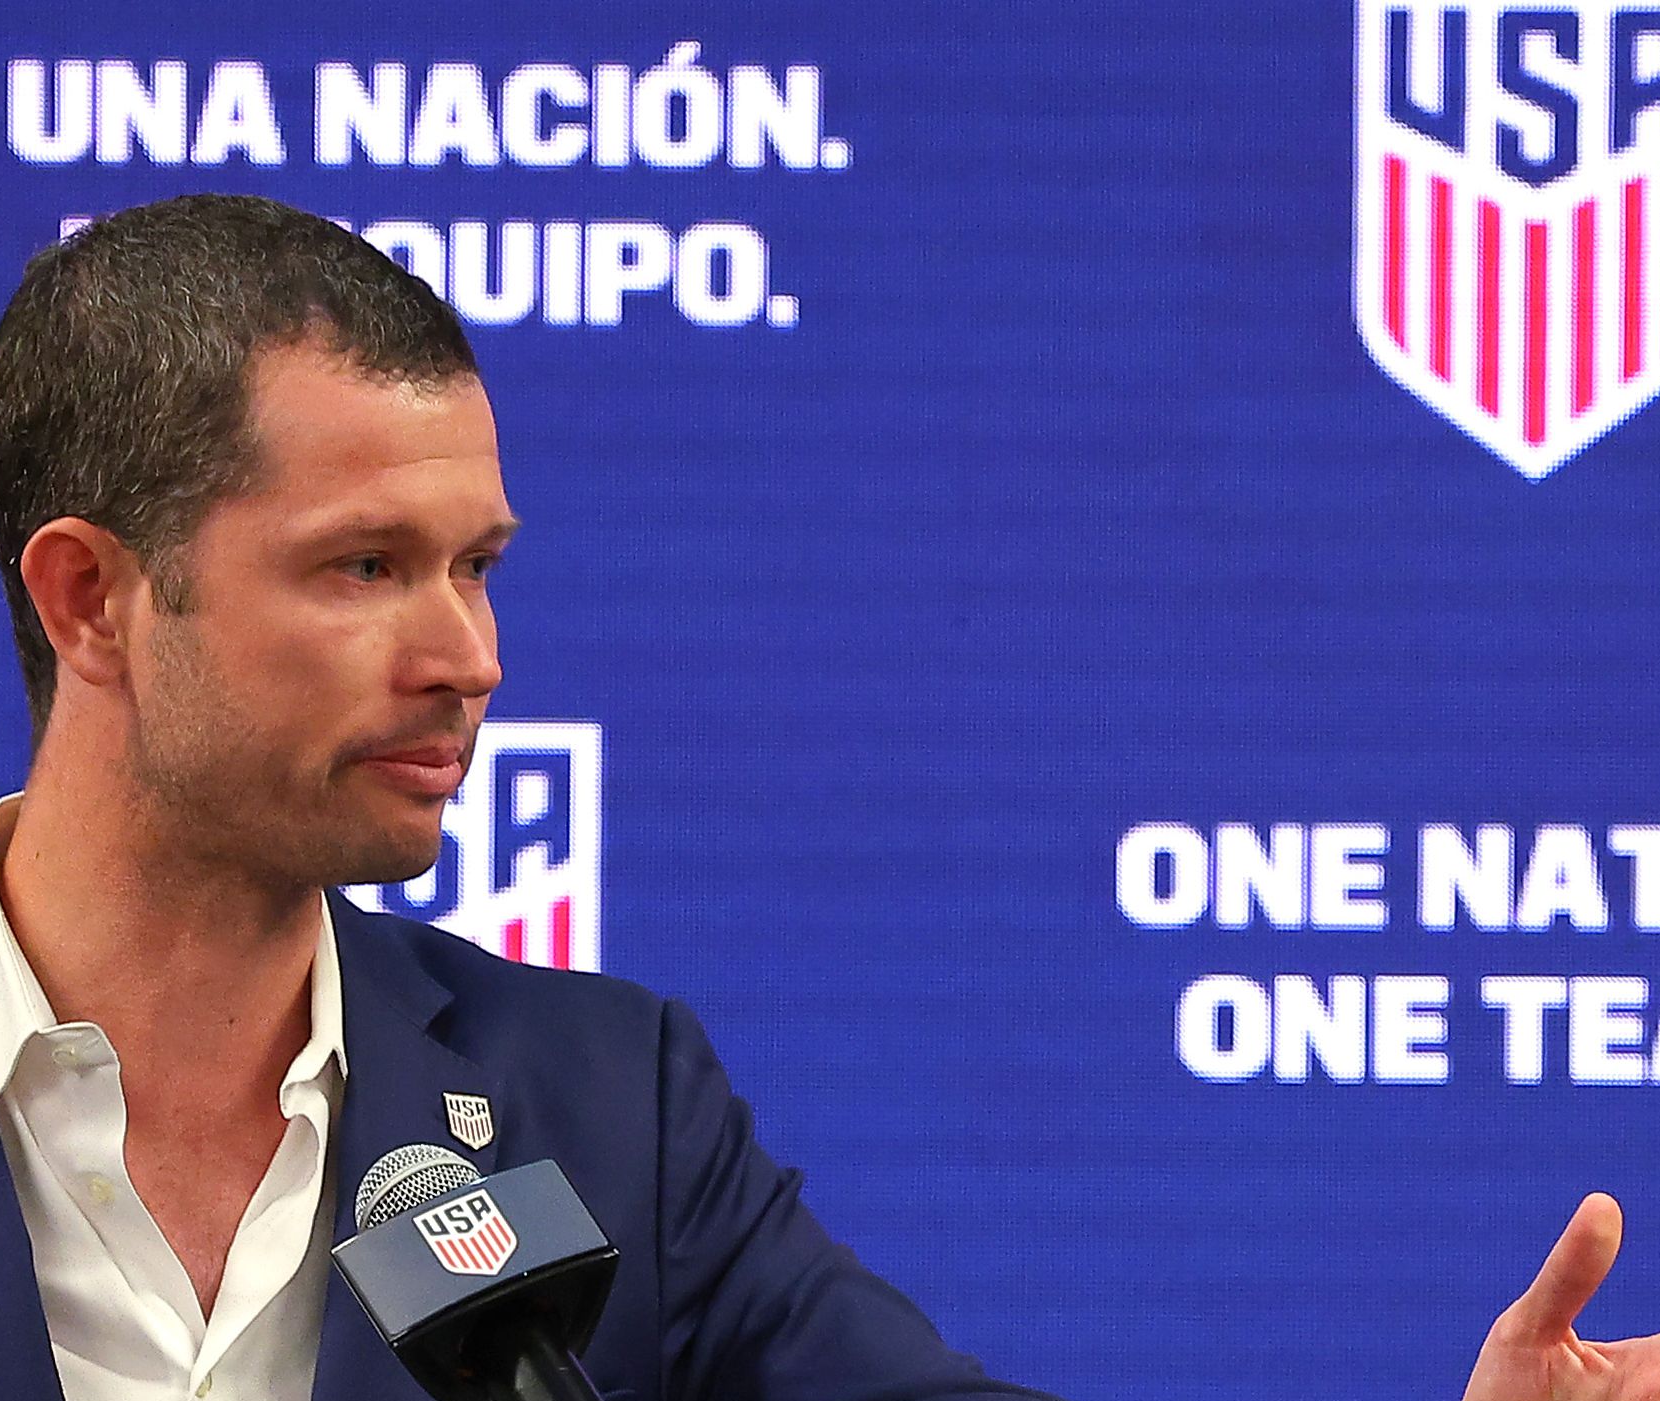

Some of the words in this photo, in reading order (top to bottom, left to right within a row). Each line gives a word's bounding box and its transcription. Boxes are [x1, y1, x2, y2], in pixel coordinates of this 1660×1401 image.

[6, 58, 288, 167] UNA
[313, 41, 855, 170] NACIÓN.
[1114, 820, 1392, 932] ONE
[1173, 973, 1451, 1086] ONE
[449, 1098, 487, 1118] USA
[421, 1195, 492, 1237] USA
